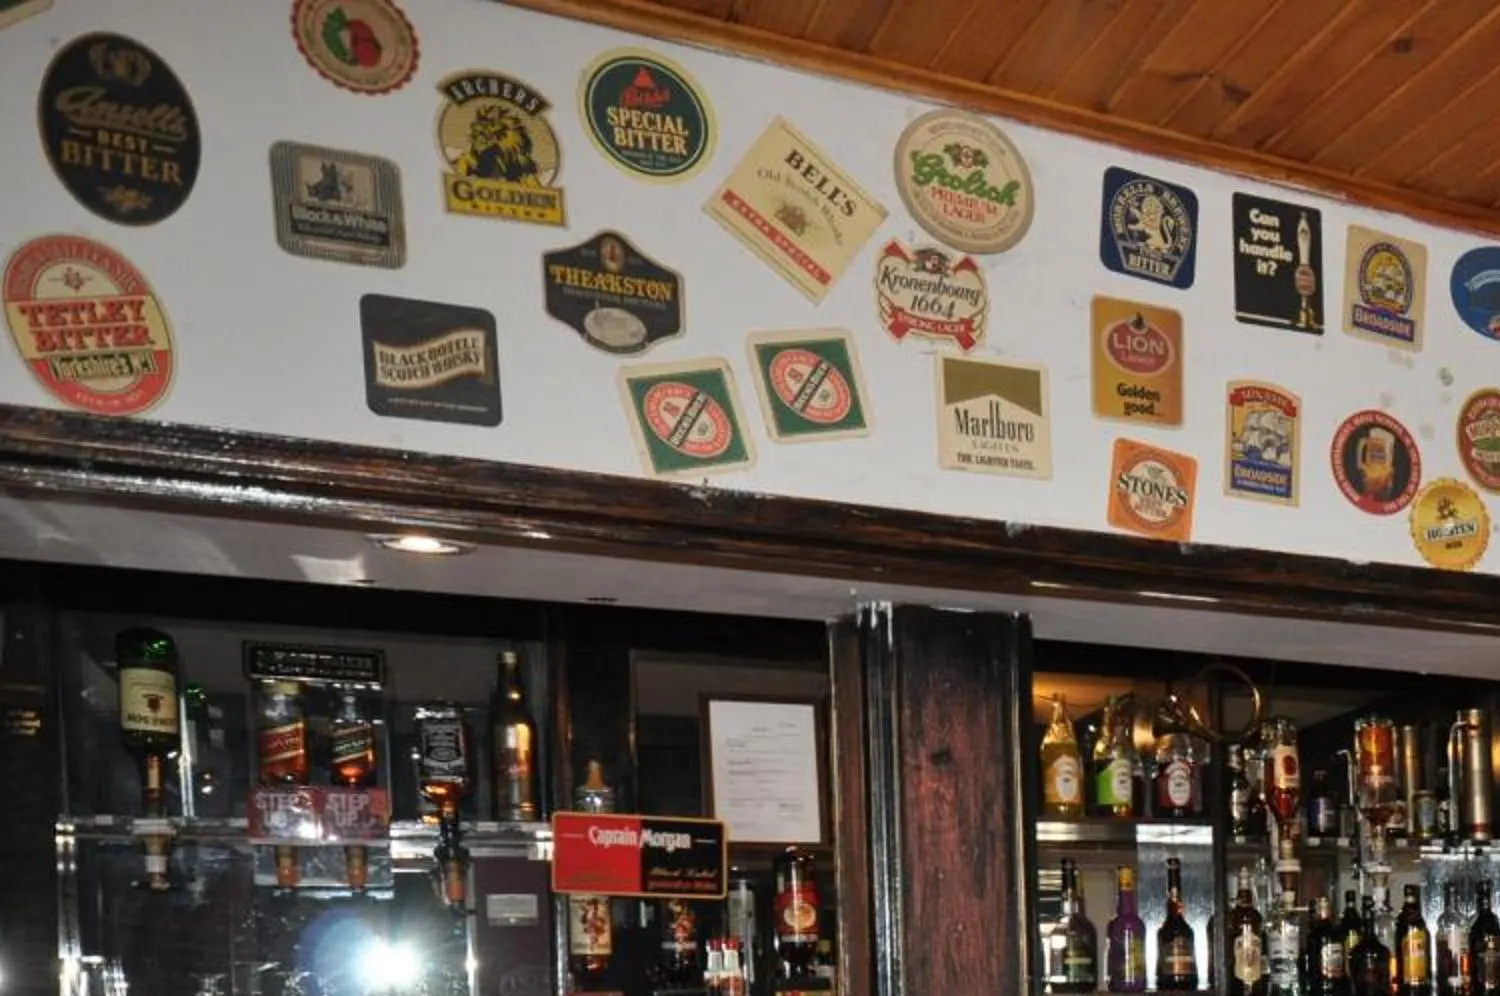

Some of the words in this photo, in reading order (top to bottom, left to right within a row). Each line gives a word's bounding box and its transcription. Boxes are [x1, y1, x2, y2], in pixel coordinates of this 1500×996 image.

[450, 76, 539, 113] ARCHERS
[606, 106, 689, 137] SPECIAL
[614, 127, 688, 156] BITTER
[60, 140, 183, 187] BITTER
[910, 150, 1020, 206] Grolsch
[784, 149, 857, 218] BELL'S
[1249, 207, 1279, 228] Can
[1251, 228, 1280, 244] you
[1239, 239, 1293, 263] handle
[549, 264, 674, 301] THEAKSTON
[1256, 260, 1278, 277] it?
[880, 266, 981, 307] Kronenbourg
[19, 299, 146, 328] TETLEY
[911, 295, 955, 318] 1664
[30, 325, 156, 353] BITTER
[380, 350, 428, 366] BLACK
[428, 337, 478, 360] BOTTLE
[1113, 333, 1165, 356] LION
[380, 365, 430, 381] SCOTCH
[431, 351, 480, 375] WHISKY
[1117, 383, 1160, 402] Golden
[954, 400, 1035, 442] Marlboro
[1117, 471, 1187, 507] STONES
[588, 826, 637, 848] Captain
[639, 829, 691, 852] Morgan
